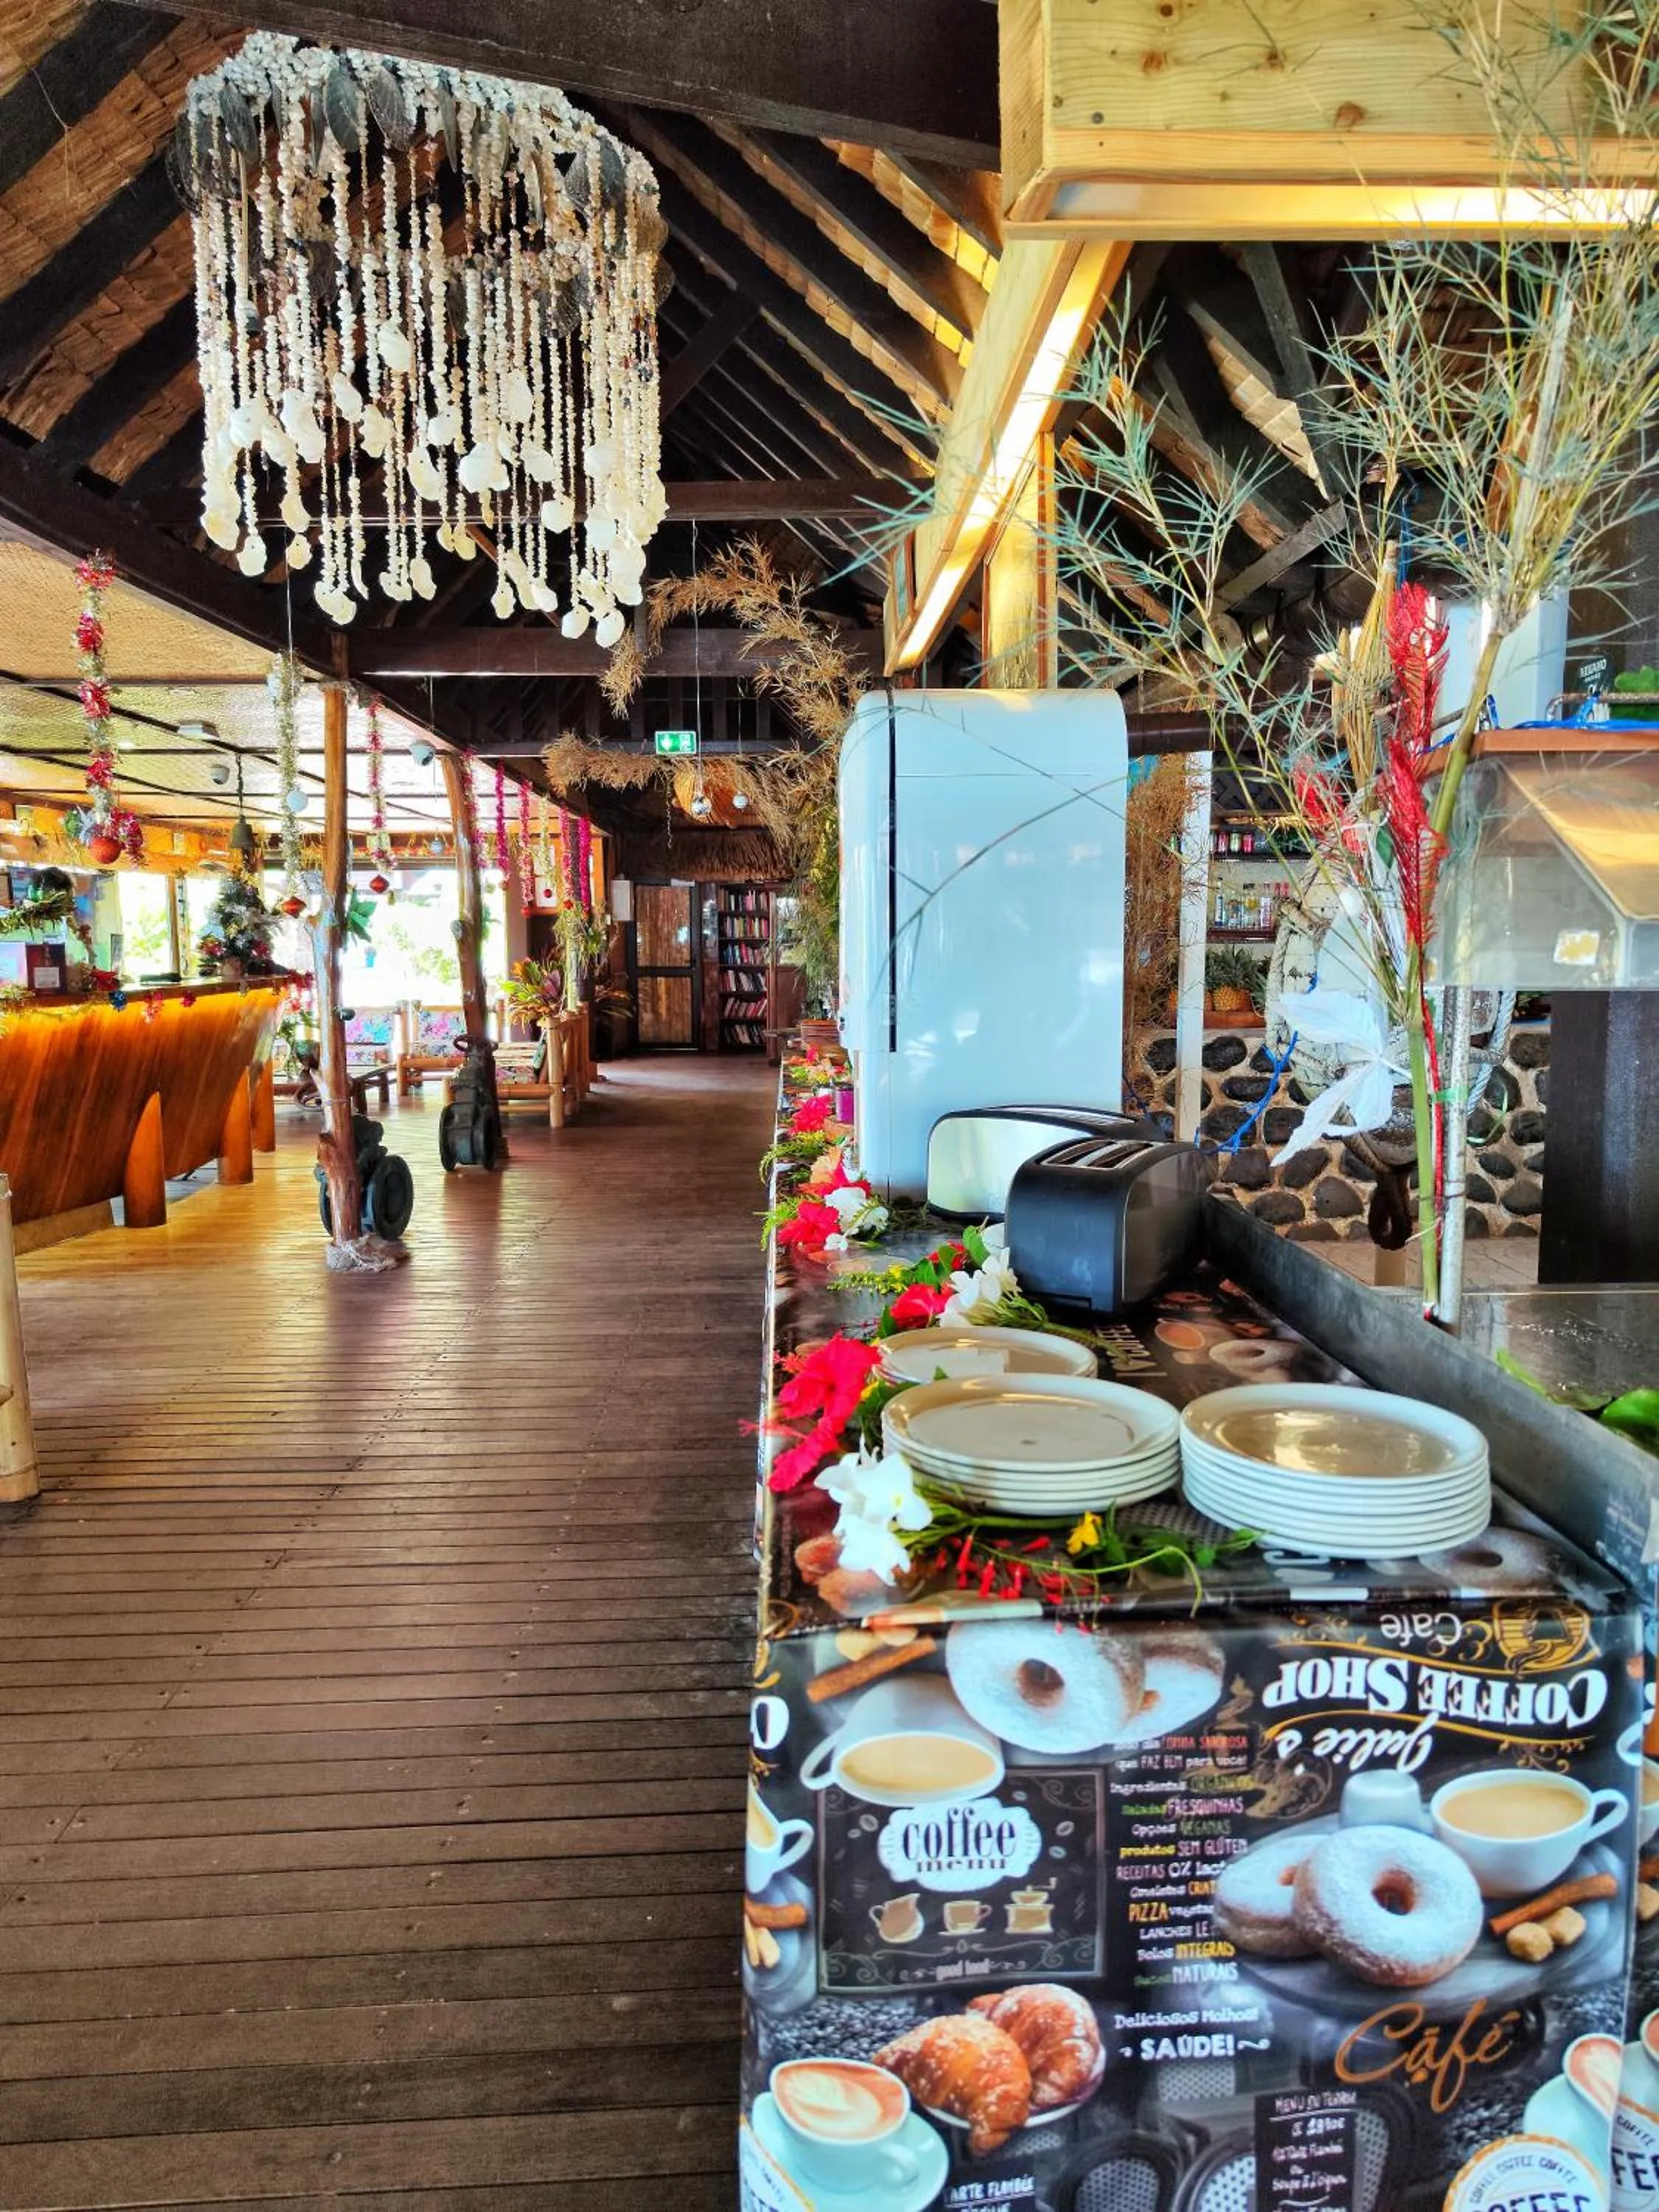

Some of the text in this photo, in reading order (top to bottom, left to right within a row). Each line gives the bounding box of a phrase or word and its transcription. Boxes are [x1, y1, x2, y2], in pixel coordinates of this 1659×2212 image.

[1379, 1613, 1463, 1646] Cafe
[1262, 1656, 1608, 1729] COFFEE SHOP
[1274, 1710, 1439, 1776] Julie's
[902, 1806, 1016, 1861] coffee
[1119, 1843, 1177, 1859] produtos
[1178, 1840, 1201, 1857] SEM
[1116, 1864, 1166, 1880] RECEITAS
[1168, 1860, 1192, 1878] 0%
[1128, 1902, 1169, 1923] PIZZA
[1172, 1961, 1239, 1983] NATURAIS
[1140, 2033, 1236, 2061] SAÚDE!
